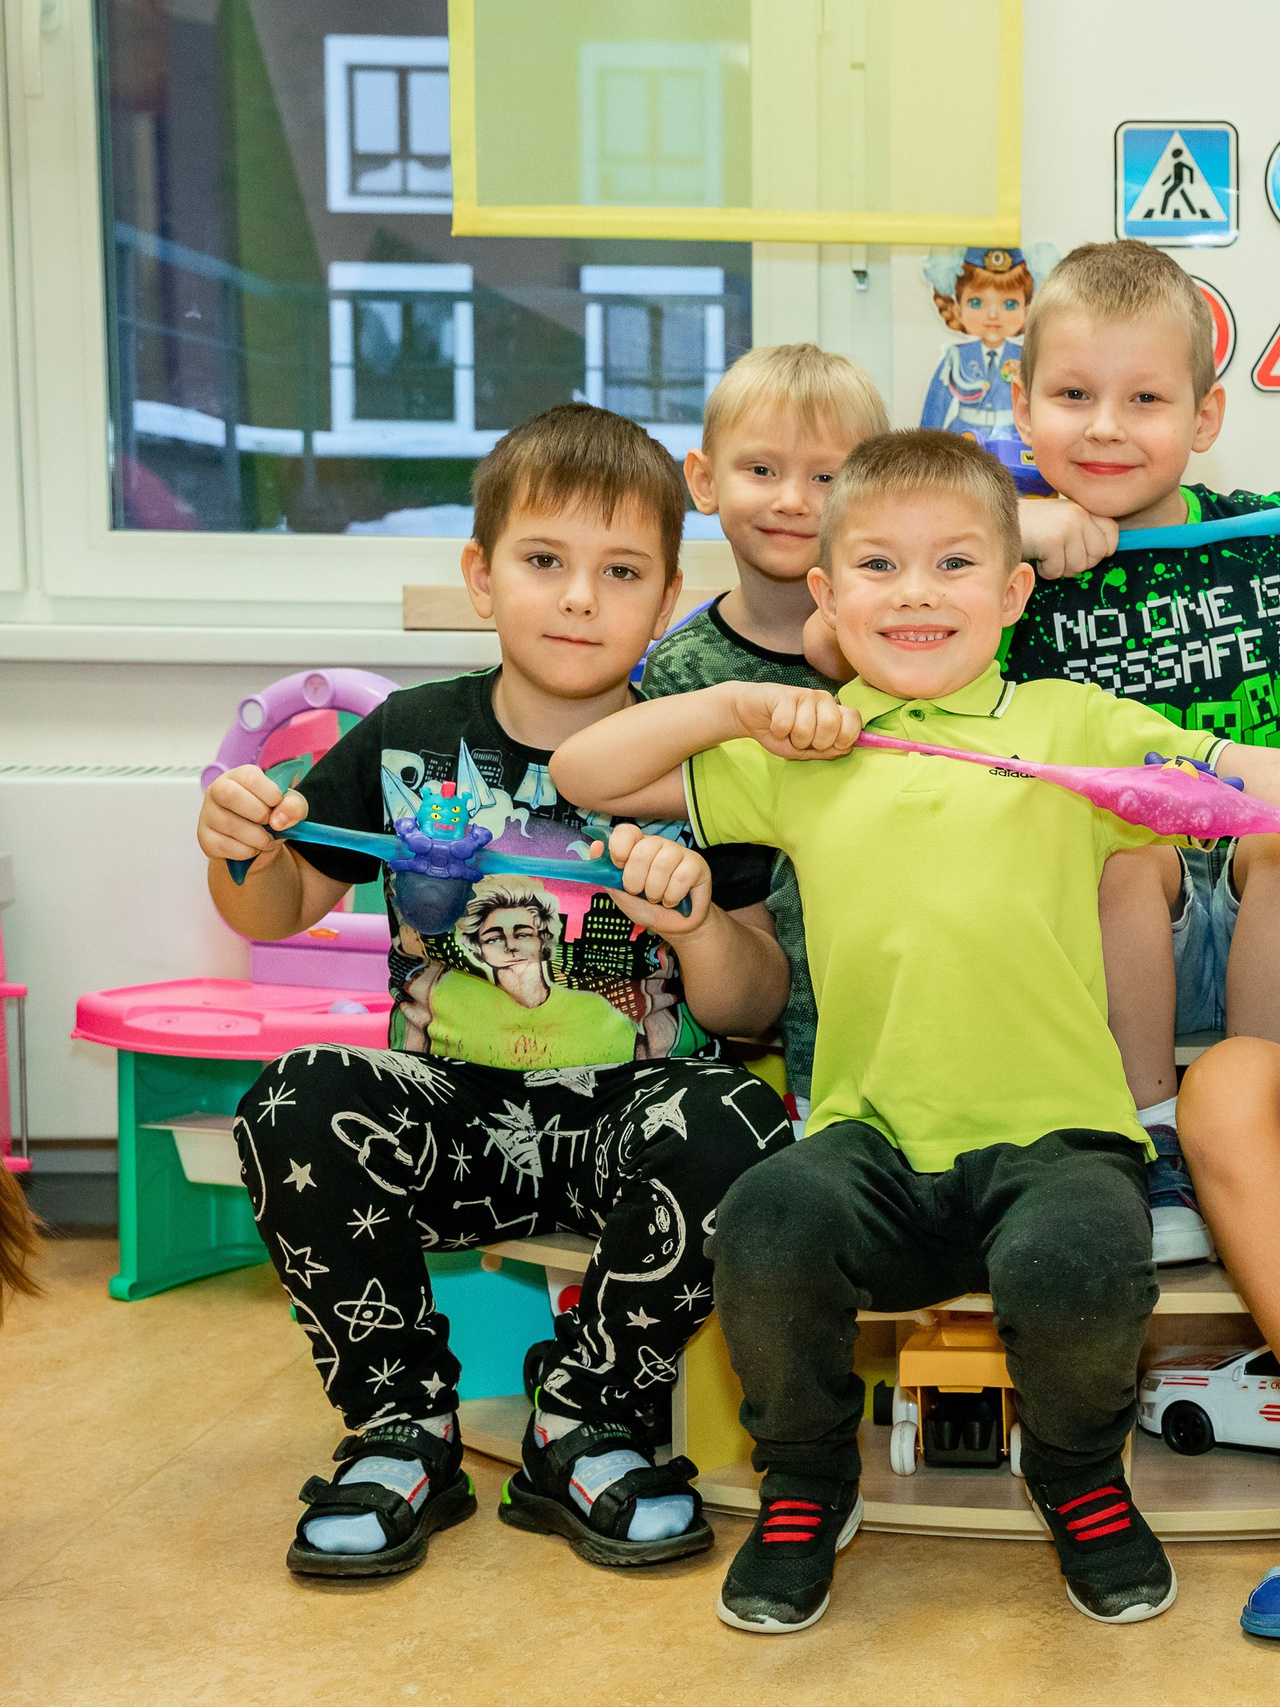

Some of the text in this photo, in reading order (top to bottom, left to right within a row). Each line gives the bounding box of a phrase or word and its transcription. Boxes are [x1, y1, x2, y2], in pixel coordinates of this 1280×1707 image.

[1053, 608, 1128, 652] NO
[1141, 585, 1243, 638] ONE
[988, 766, 1036, 778] adida
